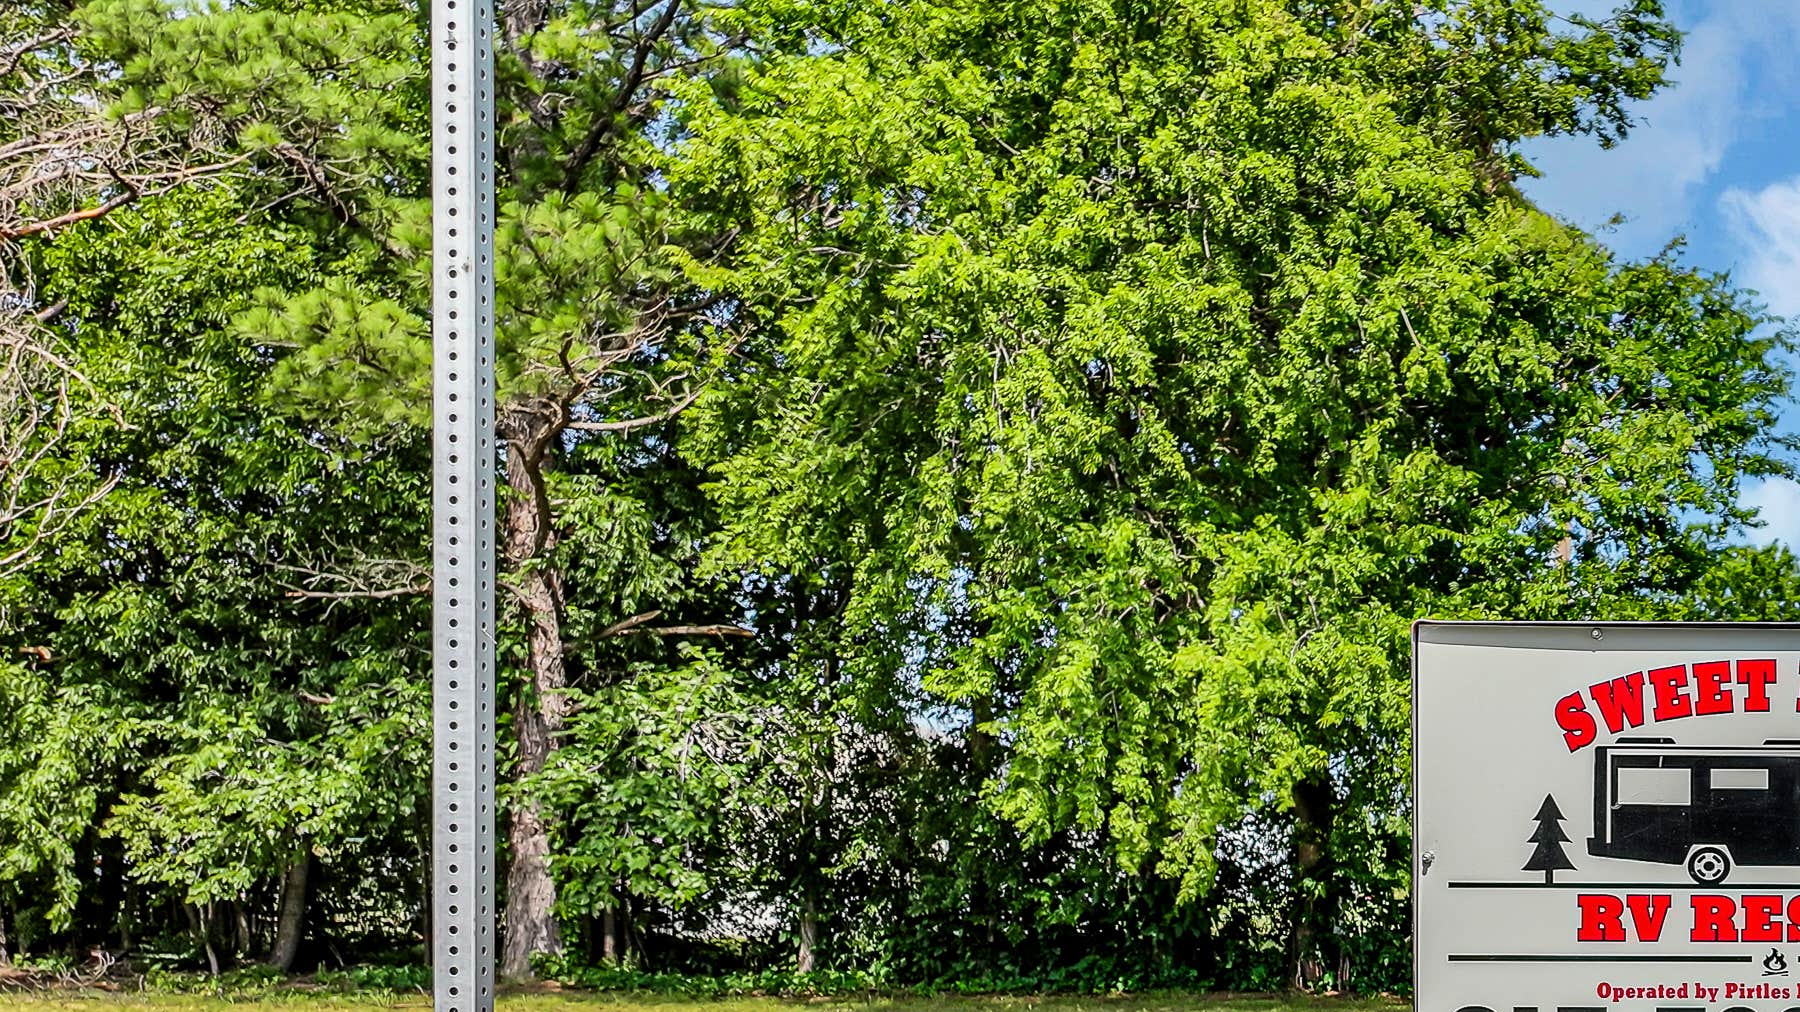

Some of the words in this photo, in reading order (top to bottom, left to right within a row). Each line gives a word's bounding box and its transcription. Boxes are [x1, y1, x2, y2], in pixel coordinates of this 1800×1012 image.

[1554, 659, 1777, 752] SWEET
[1577, 894, 1672, 943] RV
[1596, 982, 1689, 1003] Operated
[1695, 982, 1719, 1004] by
[1724, 982, 1791, 1000] Pirtles
